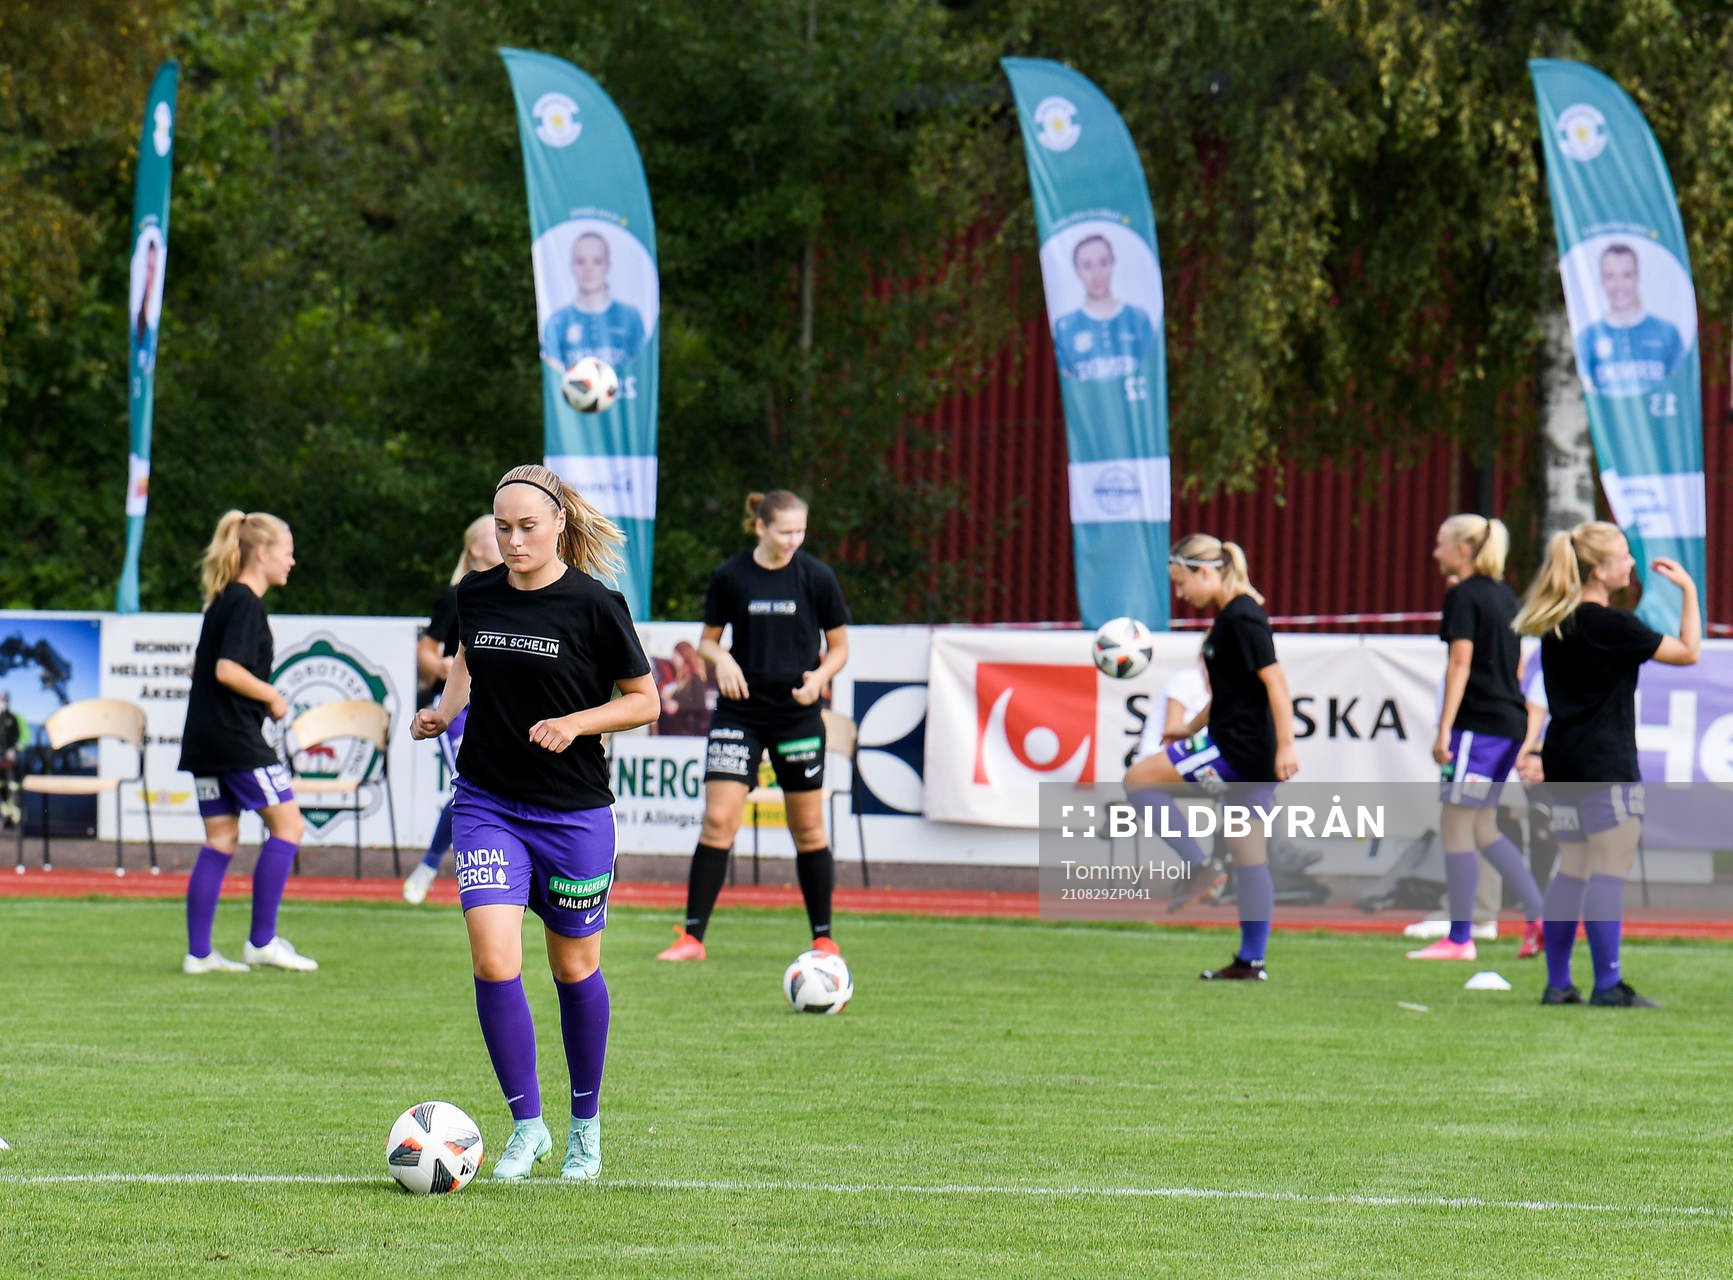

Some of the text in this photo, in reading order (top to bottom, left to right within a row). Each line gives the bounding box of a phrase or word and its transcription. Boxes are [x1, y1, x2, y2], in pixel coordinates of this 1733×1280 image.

[475, 634, 560, 654] LOTTA SCHELIN
[140, 684, 188, 699] ÅKER
[618, 757, 700, 798] NERG
[457, 866, 494, 888] NERGI
[558, 897, 591, 909] MÅLERI
